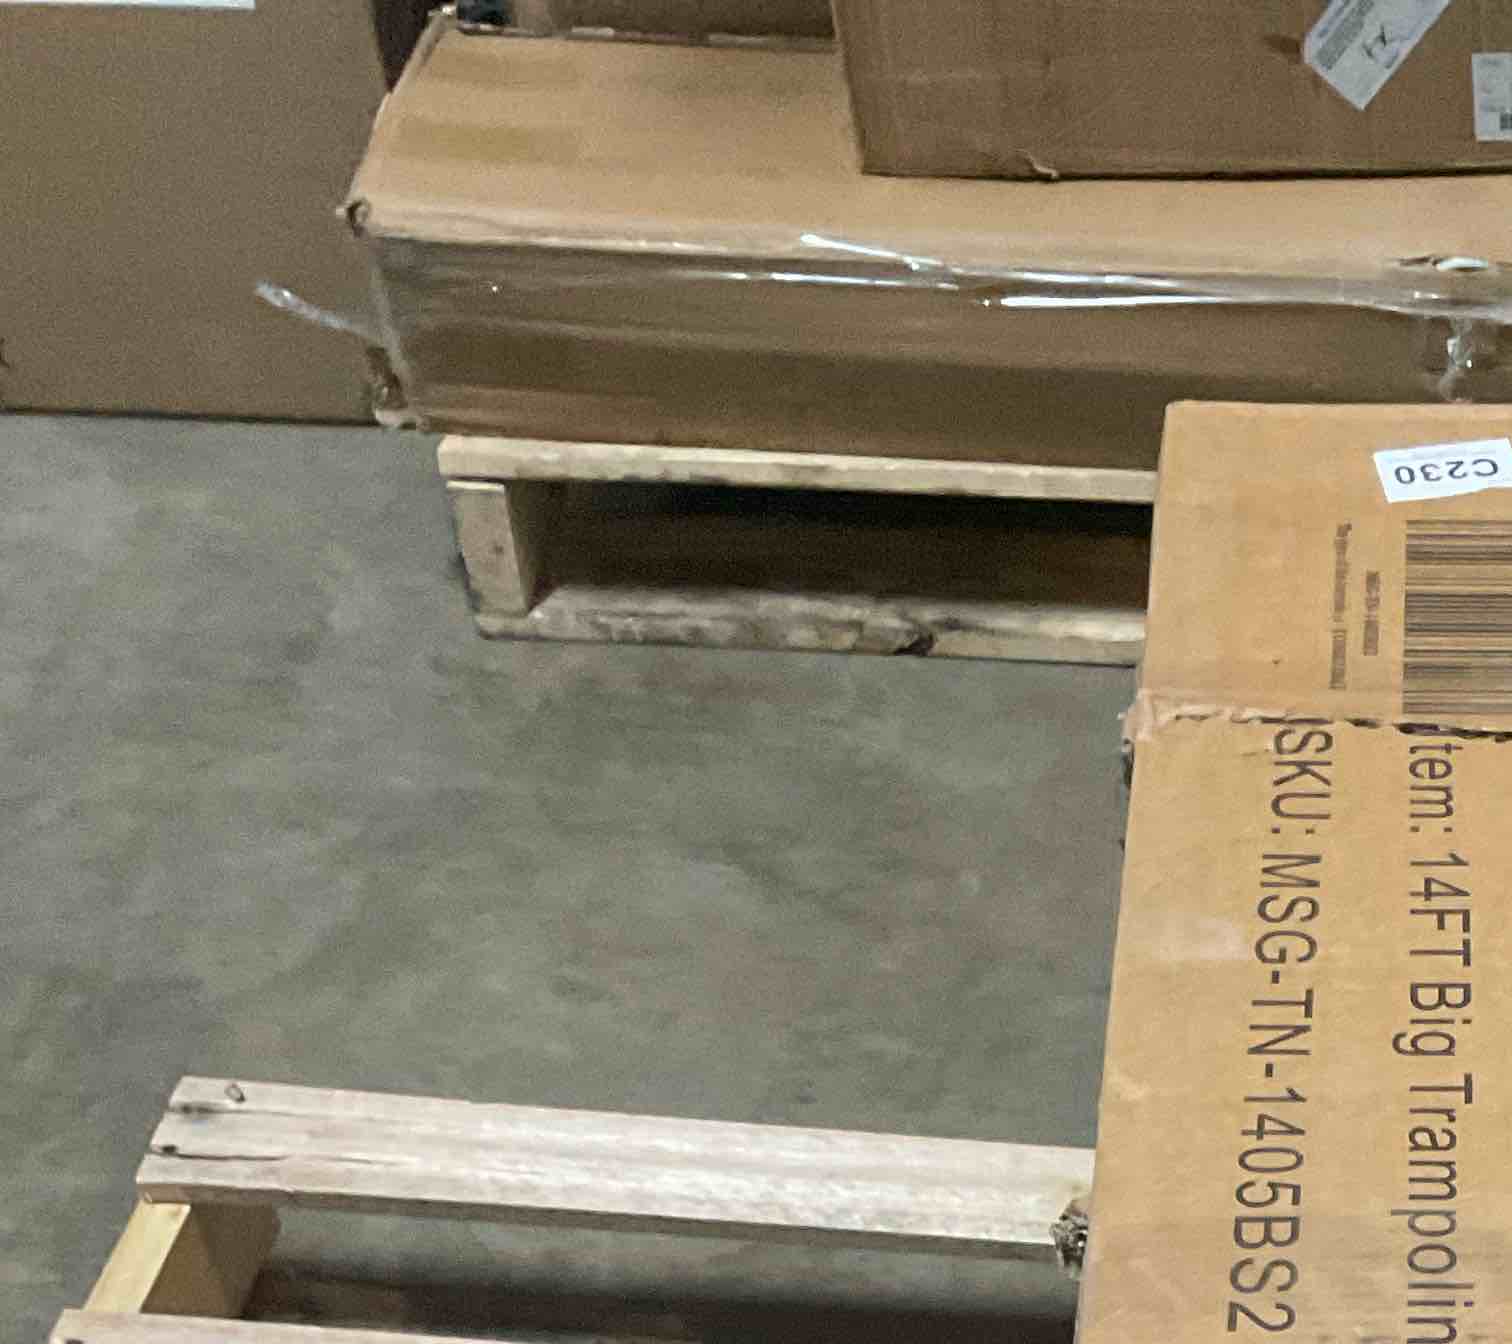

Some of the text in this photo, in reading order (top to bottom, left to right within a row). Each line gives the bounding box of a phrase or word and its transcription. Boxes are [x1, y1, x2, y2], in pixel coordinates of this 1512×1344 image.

[1395, 457, 1499, 485] C230
[1409, 852, 1473, 967] 14FT
[1226, 728, 1334, 1332] SKU: MSG-TN-1405BS2
[1391, 981, 1472, 1056] Big
